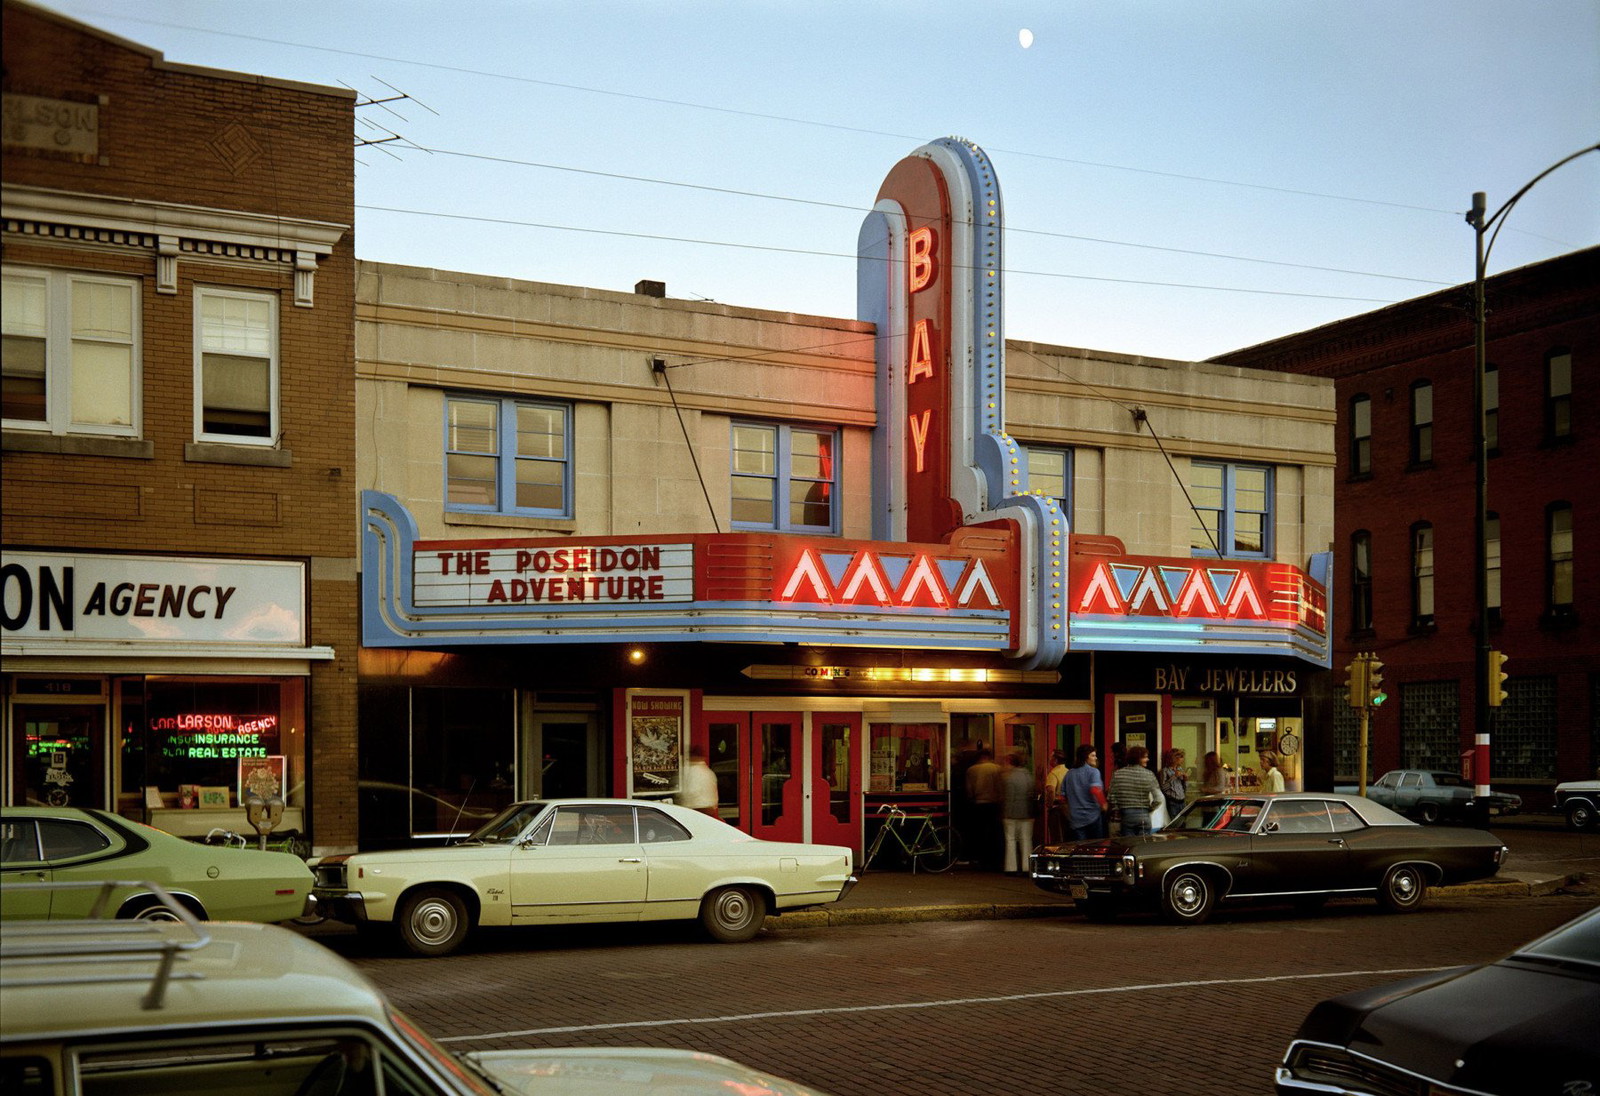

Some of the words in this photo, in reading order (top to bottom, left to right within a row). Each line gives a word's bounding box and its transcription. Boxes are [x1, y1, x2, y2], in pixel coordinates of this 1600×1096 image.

[908, 226, 935, 473] BAY
[437, 551, 491, 576] THE
[516, 547, 661, 574] POSEIDON
[83, 581, 237, 620] AGENCY
[486, 575, 665, 603] ADVENTURE
[1155, 664, 1190, 690] BAY
[1200, 667, 1297, 693] JEWELERS
[633, 701, 649, 710] NOW
[650, 701, 682, 711] SHOWING
[177, 714, 232, 729] LARSON
[237, 715, 277, 734] AGENCY
[188, 747, 219, 759] REAL
[221, 747, 267, 759] ESTATE
[194, 733, 260, 745] INSURANCE
